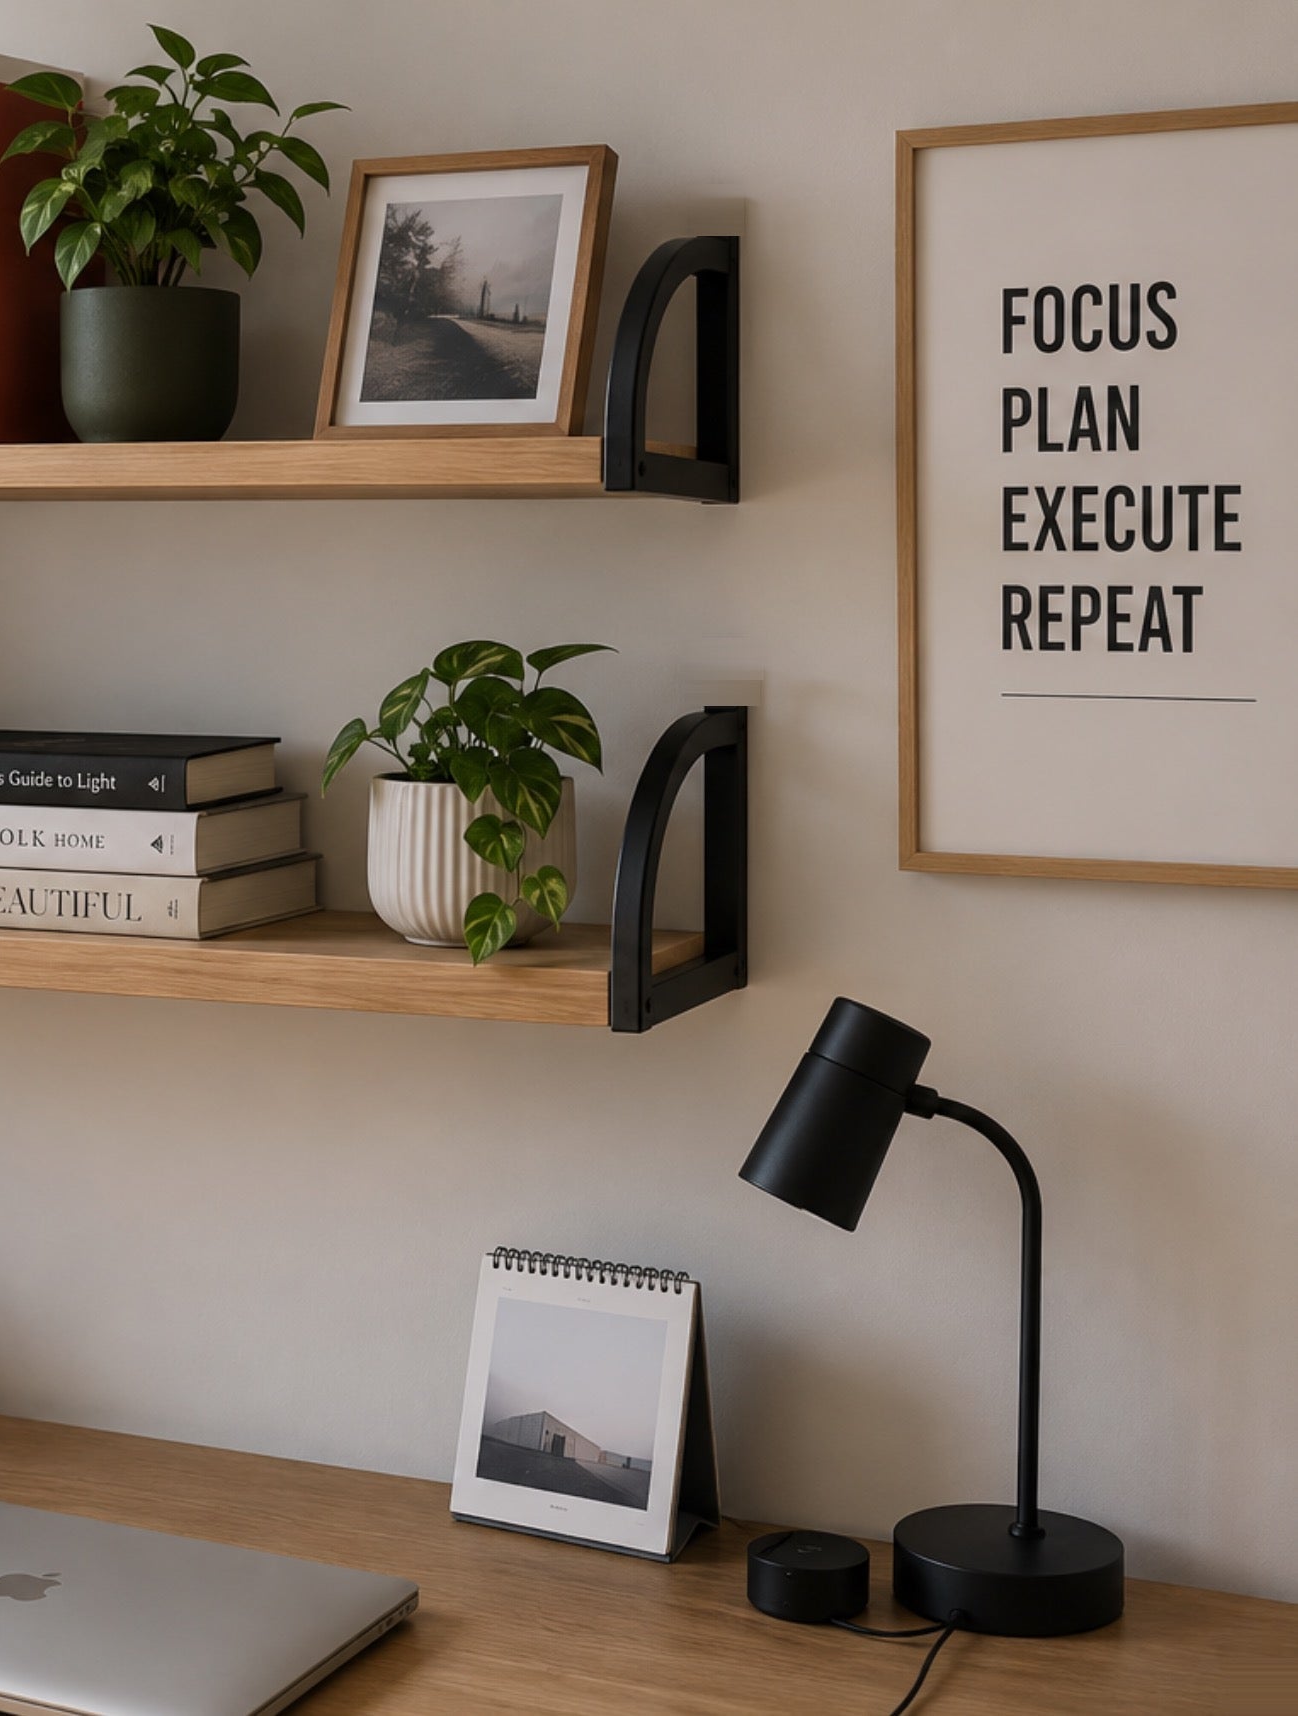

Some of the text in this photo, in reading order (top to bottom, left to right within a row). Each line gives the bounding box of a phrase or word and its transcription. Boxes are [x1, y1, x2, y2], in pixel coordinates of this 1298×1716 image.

[1002, 281, 1178, 354] FOCUS
[1002, 385, 1140, 454] PLAN
[1002, 485, 1242, 553] EXECUTE
[1002, 585, 1204, 654] REPEAT
[8, 769, 54, 788] Guide
[57, 774, 73, 789] to
[77, 772, 117, 793] Light
[54, 833, 106, 850] HOME
